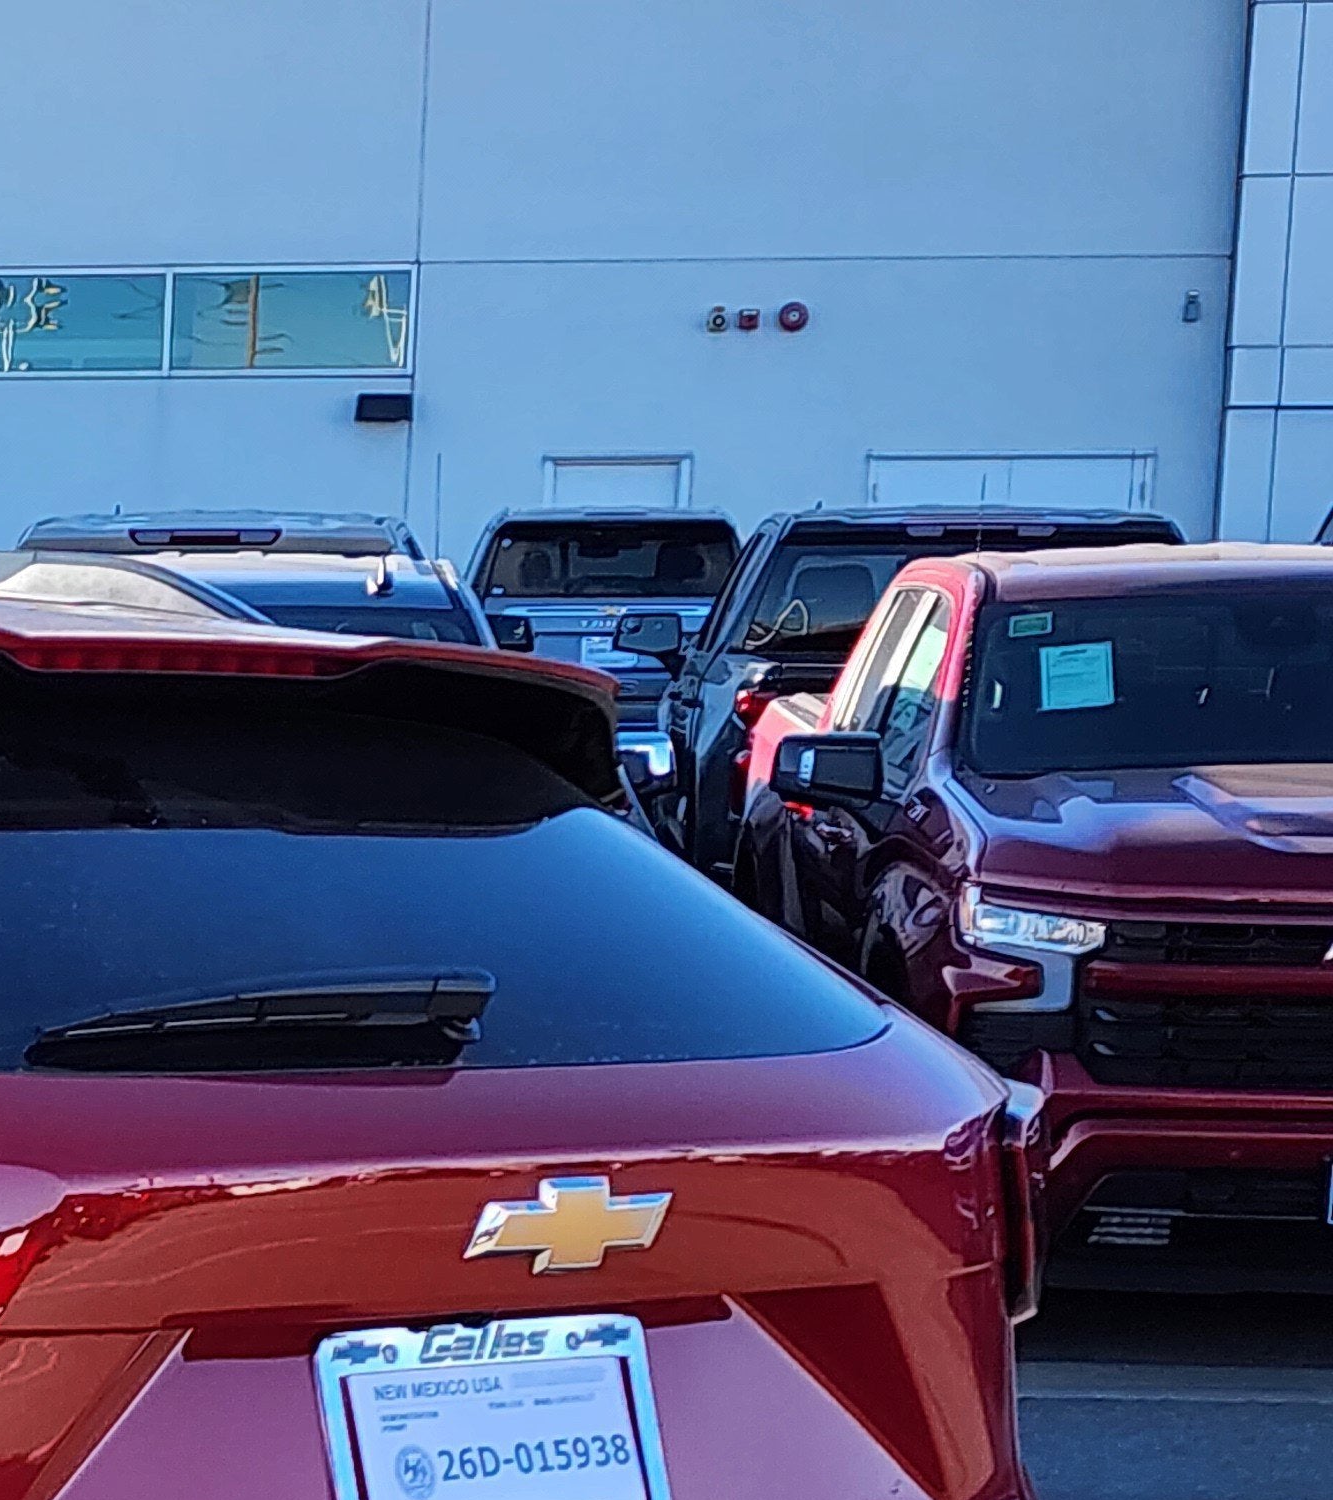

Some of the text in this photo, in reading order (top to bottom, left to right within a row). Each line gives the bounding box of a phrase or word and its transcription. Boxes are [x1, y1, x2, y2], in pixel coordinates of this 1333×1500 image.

[419, 1322, 550, 1364] Galles
[374, 1376, 503, 1401] NEW MEXICO USA
[437, 1433, 632, 1482] 26D-015938
